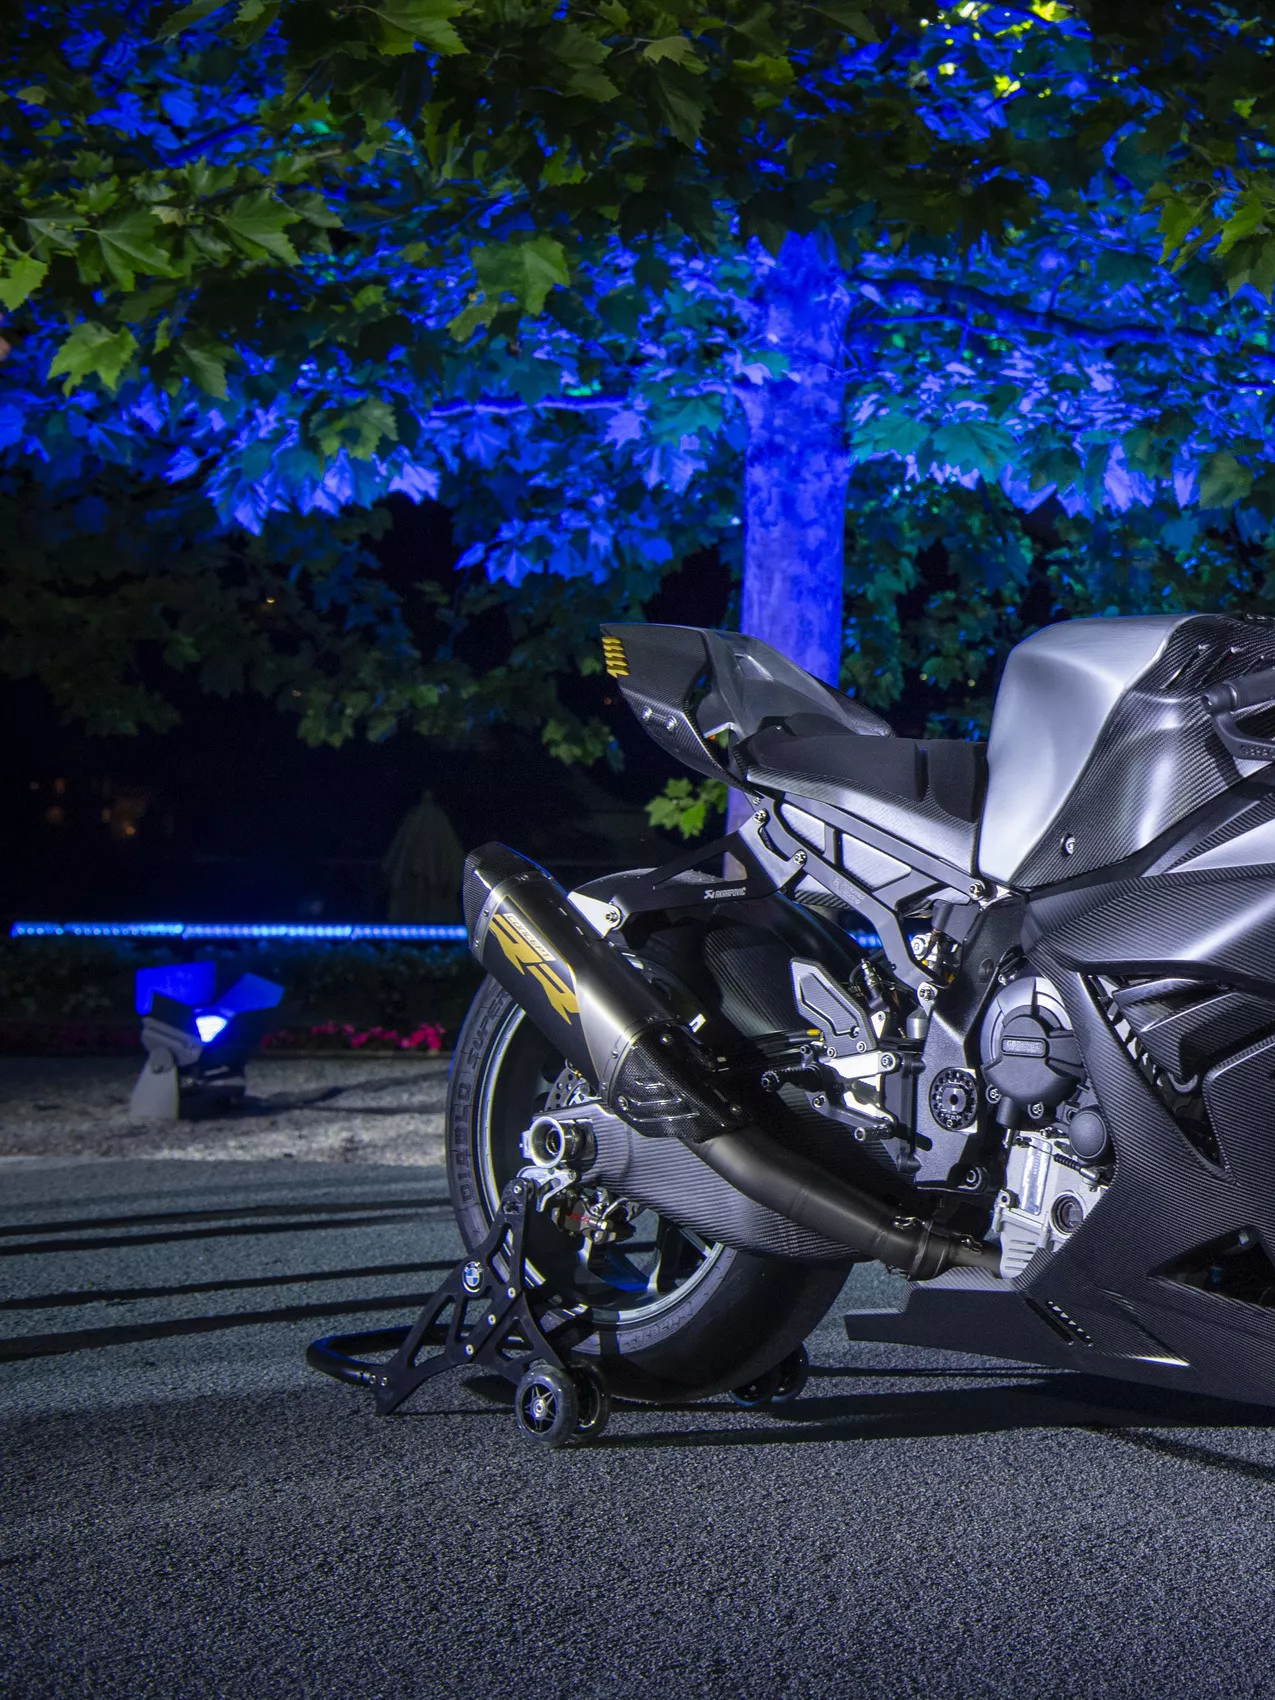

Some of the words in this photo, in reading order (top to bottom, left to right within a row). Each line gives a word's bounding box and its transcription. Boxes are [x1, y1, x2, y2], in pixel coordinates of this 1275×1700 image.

[506, 915, 551, 959] CONCEPT
[454, 1081, 473, 1202] DIABLO
[467, 990, 512, 1069] SUPER
